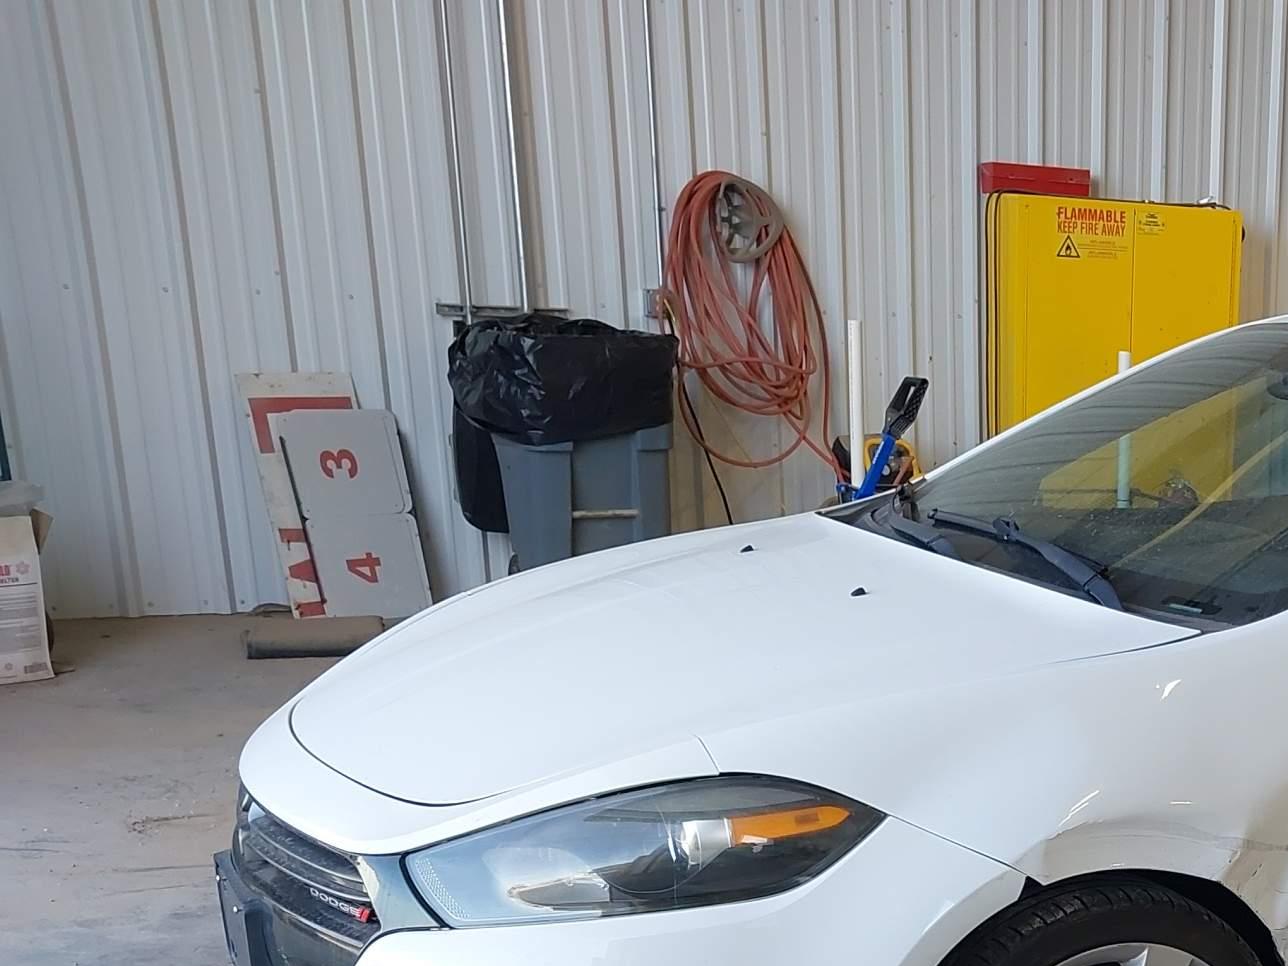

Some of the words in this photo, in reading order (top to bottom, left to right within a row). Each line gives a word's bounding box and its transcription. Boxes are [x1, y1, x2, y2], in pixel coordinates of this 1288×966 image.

[1057, 206, 1126, 224] FLAMMABLE
[1057, 220, 1078, 234] KEEP
[1080, 222, 1099, 236] FIRE
[1101, 223, 1126, 237] AWAY
[319, 448, 359, 480] 3
[345, 551, 382, 584] 4
[309, 887, 361, 918] DODGE
